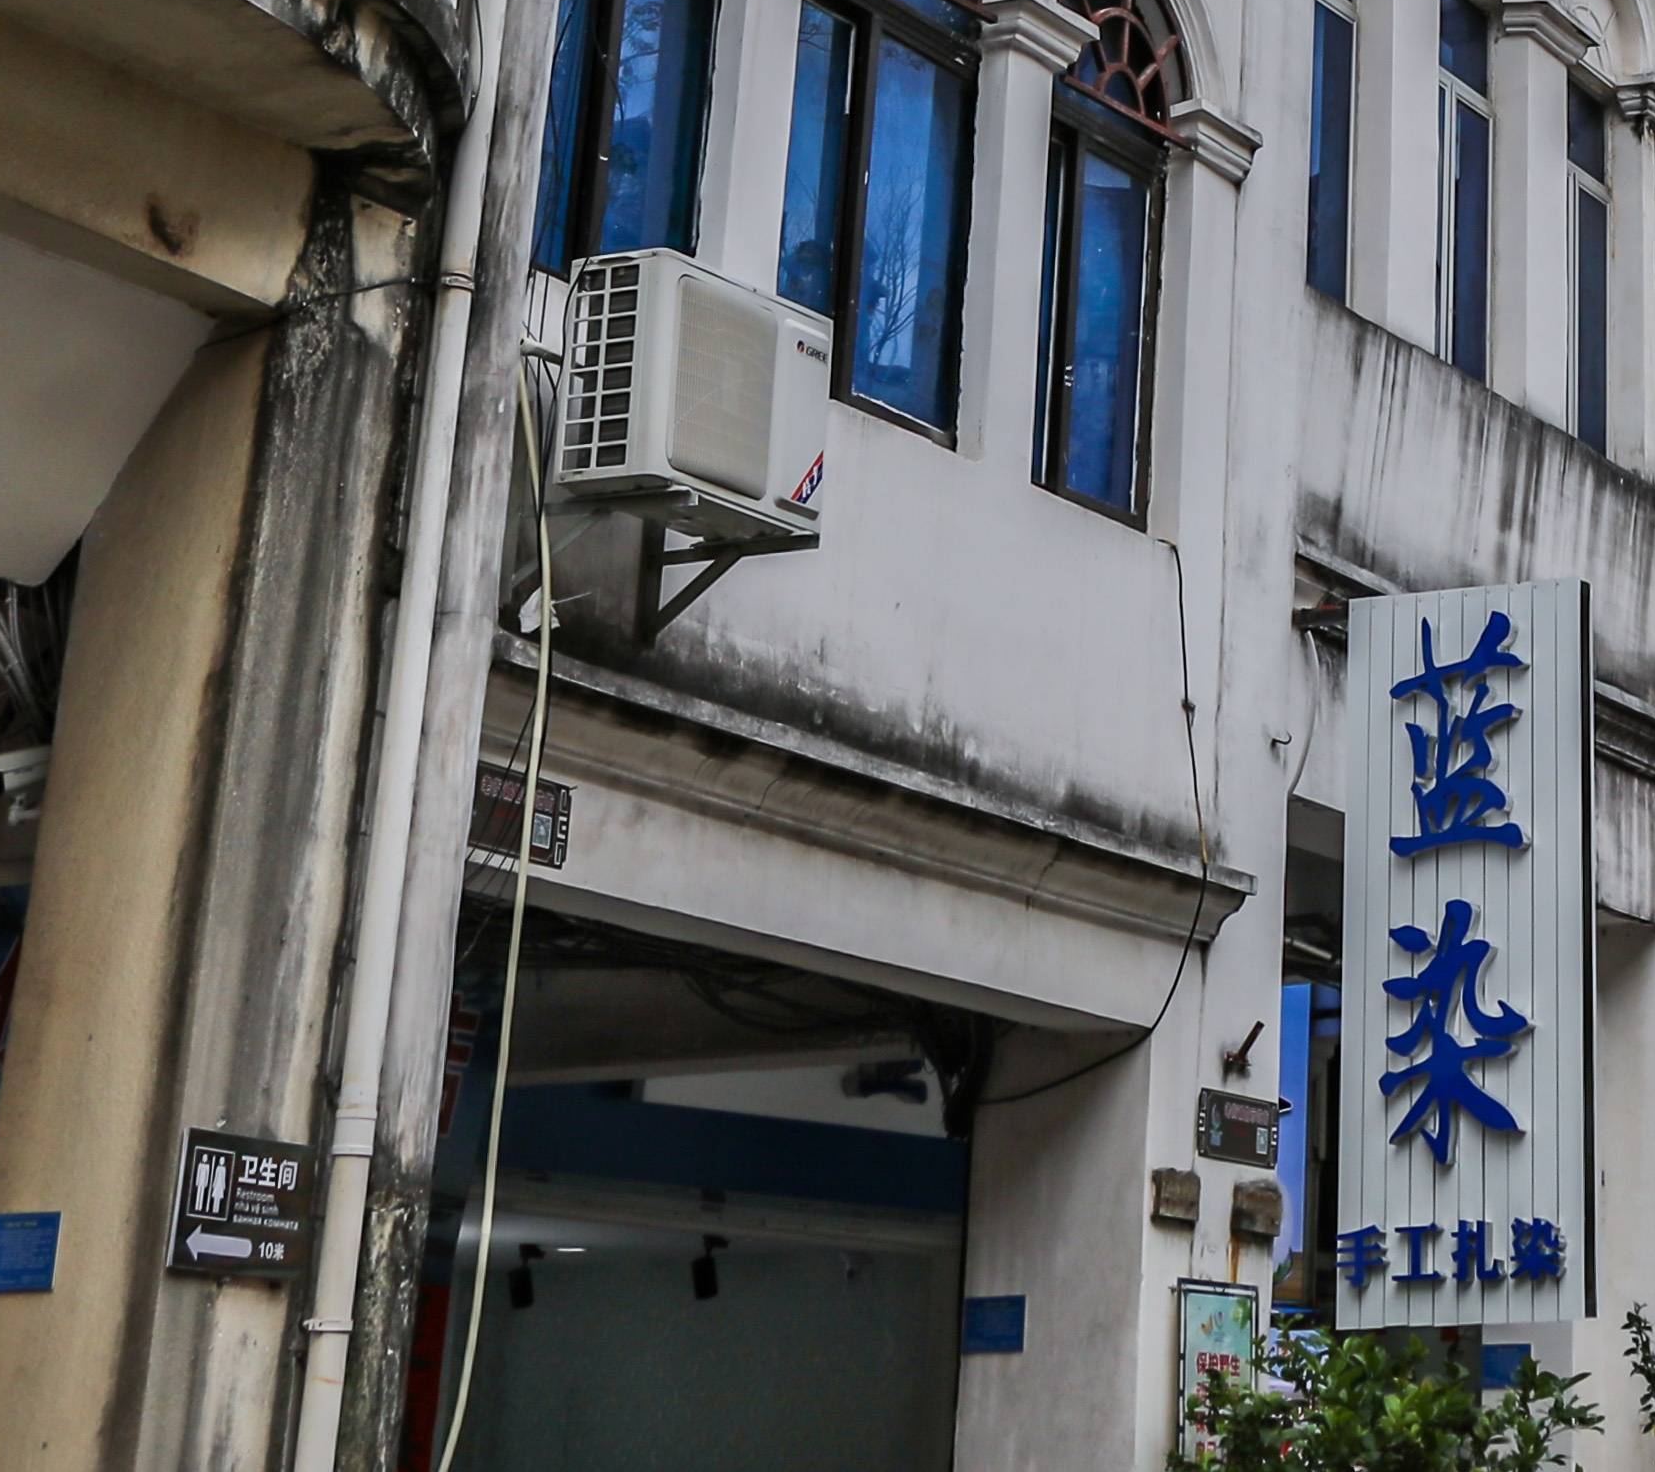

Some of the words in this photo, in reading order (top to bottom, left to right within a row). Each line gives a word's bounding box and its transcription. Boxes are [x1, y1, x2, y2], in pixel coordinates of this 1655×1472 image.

[1379, 610, 1536, 1165] 蓝染
[238, 1155, 299, 1190] 卫生间
[235, 1187, 275, 1203] Restroom
[258, 1241, 285, 1261] 10米
[1337, 1217, 1566, 1287] 手工扎染
